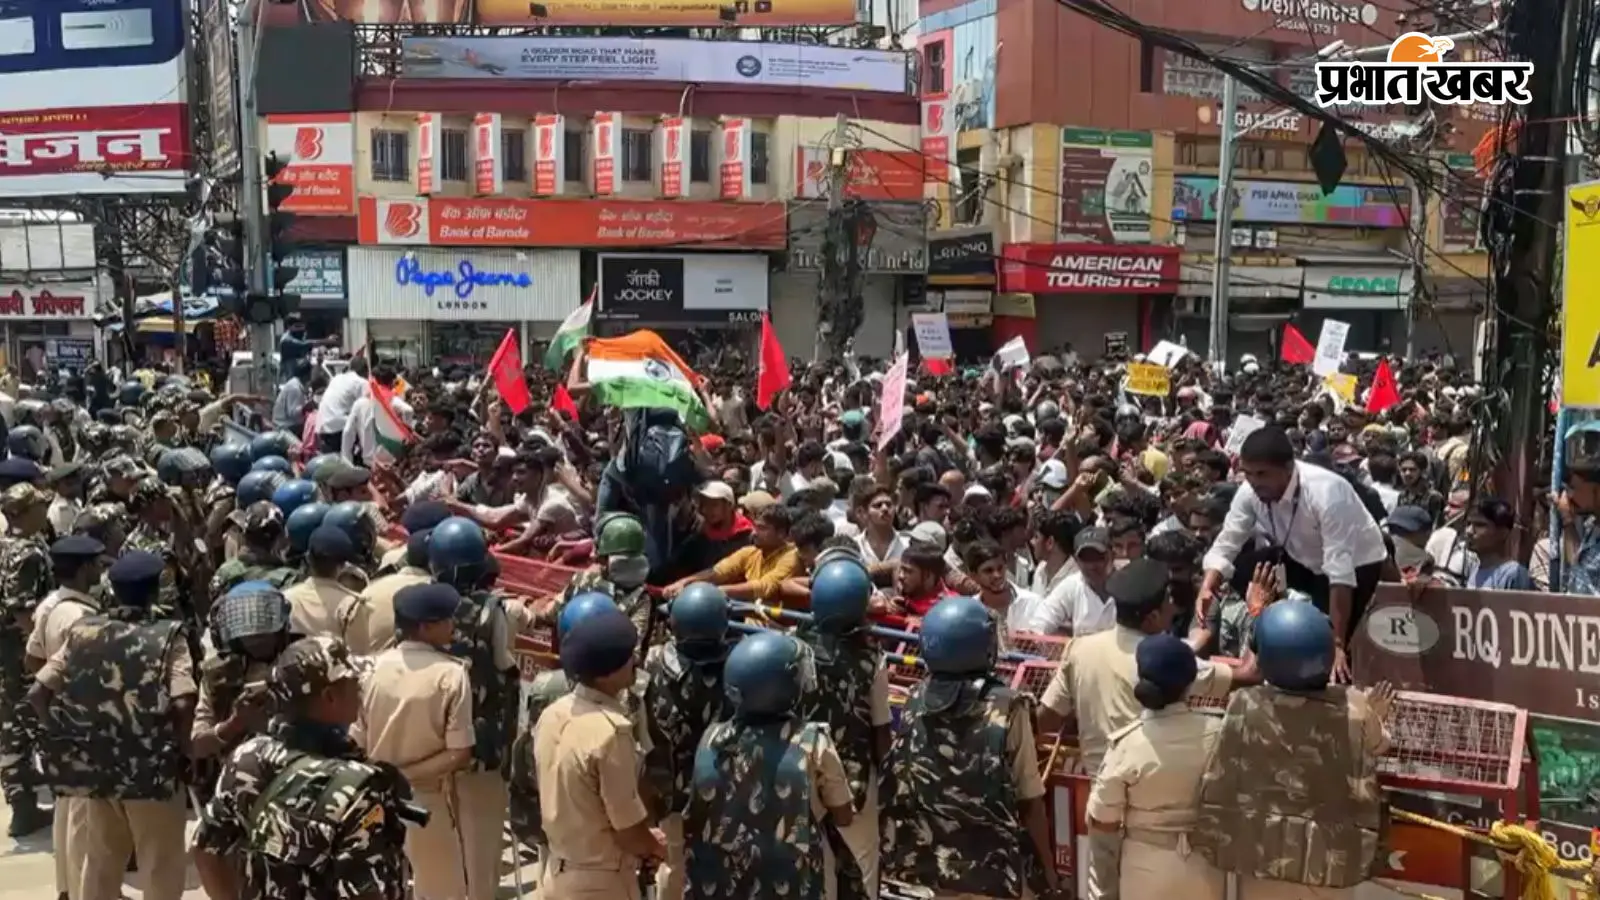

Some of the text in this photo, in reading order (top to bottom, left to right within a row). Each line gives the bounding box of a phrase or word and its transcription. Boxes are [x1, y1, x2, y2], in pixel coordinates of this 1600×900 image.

[521, 55, 559, 63] EVERY
[561, 55, 589, 63] STEP
[591, 55, 617, 63] FEEL
[440, 225, 530, 239] Bank of Baroda
[597, 226, 623, 239] Bank
[625, 226, 637, 239] of
[637, 226, 675, 240] Baroda
[1051, 256, 1163, 271] AMERICAN
[396, 255, 532, 298] Pepe Jeans
[1046, 272, 1162, 288] TOURISTER
[614, 289, 673, 301] JOCKEY
[1452, 606, 1502, 670] RQ
